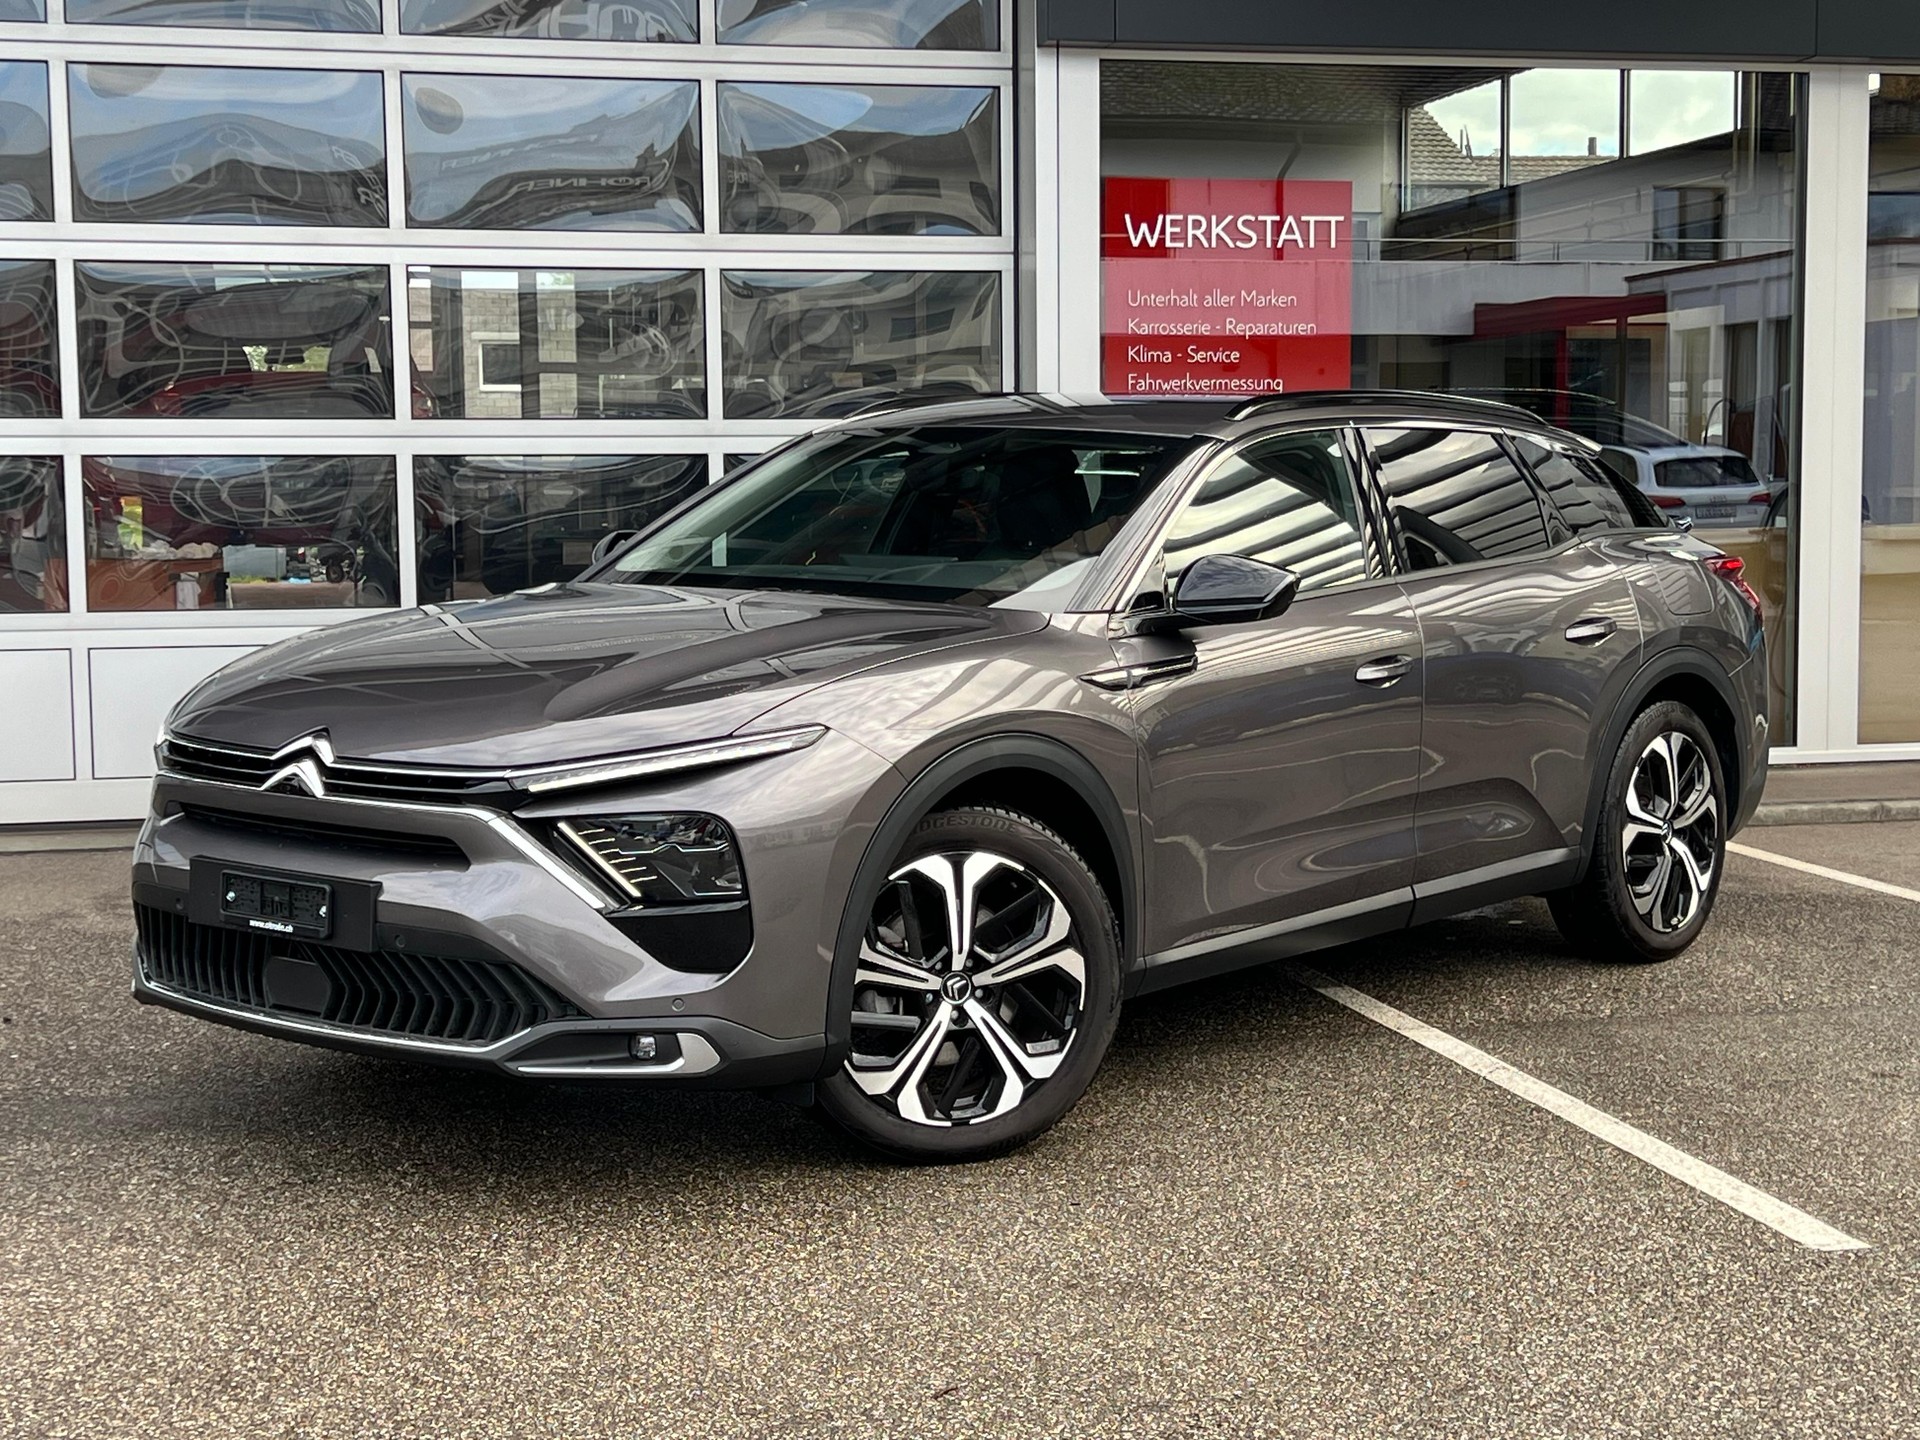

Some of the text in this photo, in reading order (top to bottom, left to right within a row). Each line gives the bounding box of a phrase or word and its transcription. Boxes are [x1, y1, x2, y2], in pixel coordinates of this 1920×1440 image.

[1124, 213, 1345, 249] WERKSTATT
[1128, 289, 1297, 308] Unterhalt aller Marken
[1128, 318, 1211, 335] Karrosserie
[1226, 318, 1317, 339] Reparaturen
[1128, 345, 1172, 363] Klima
[1187, 345, 1240, 363] Service
[1128, 373, 1283, 392] Fahrwerkvermessung
